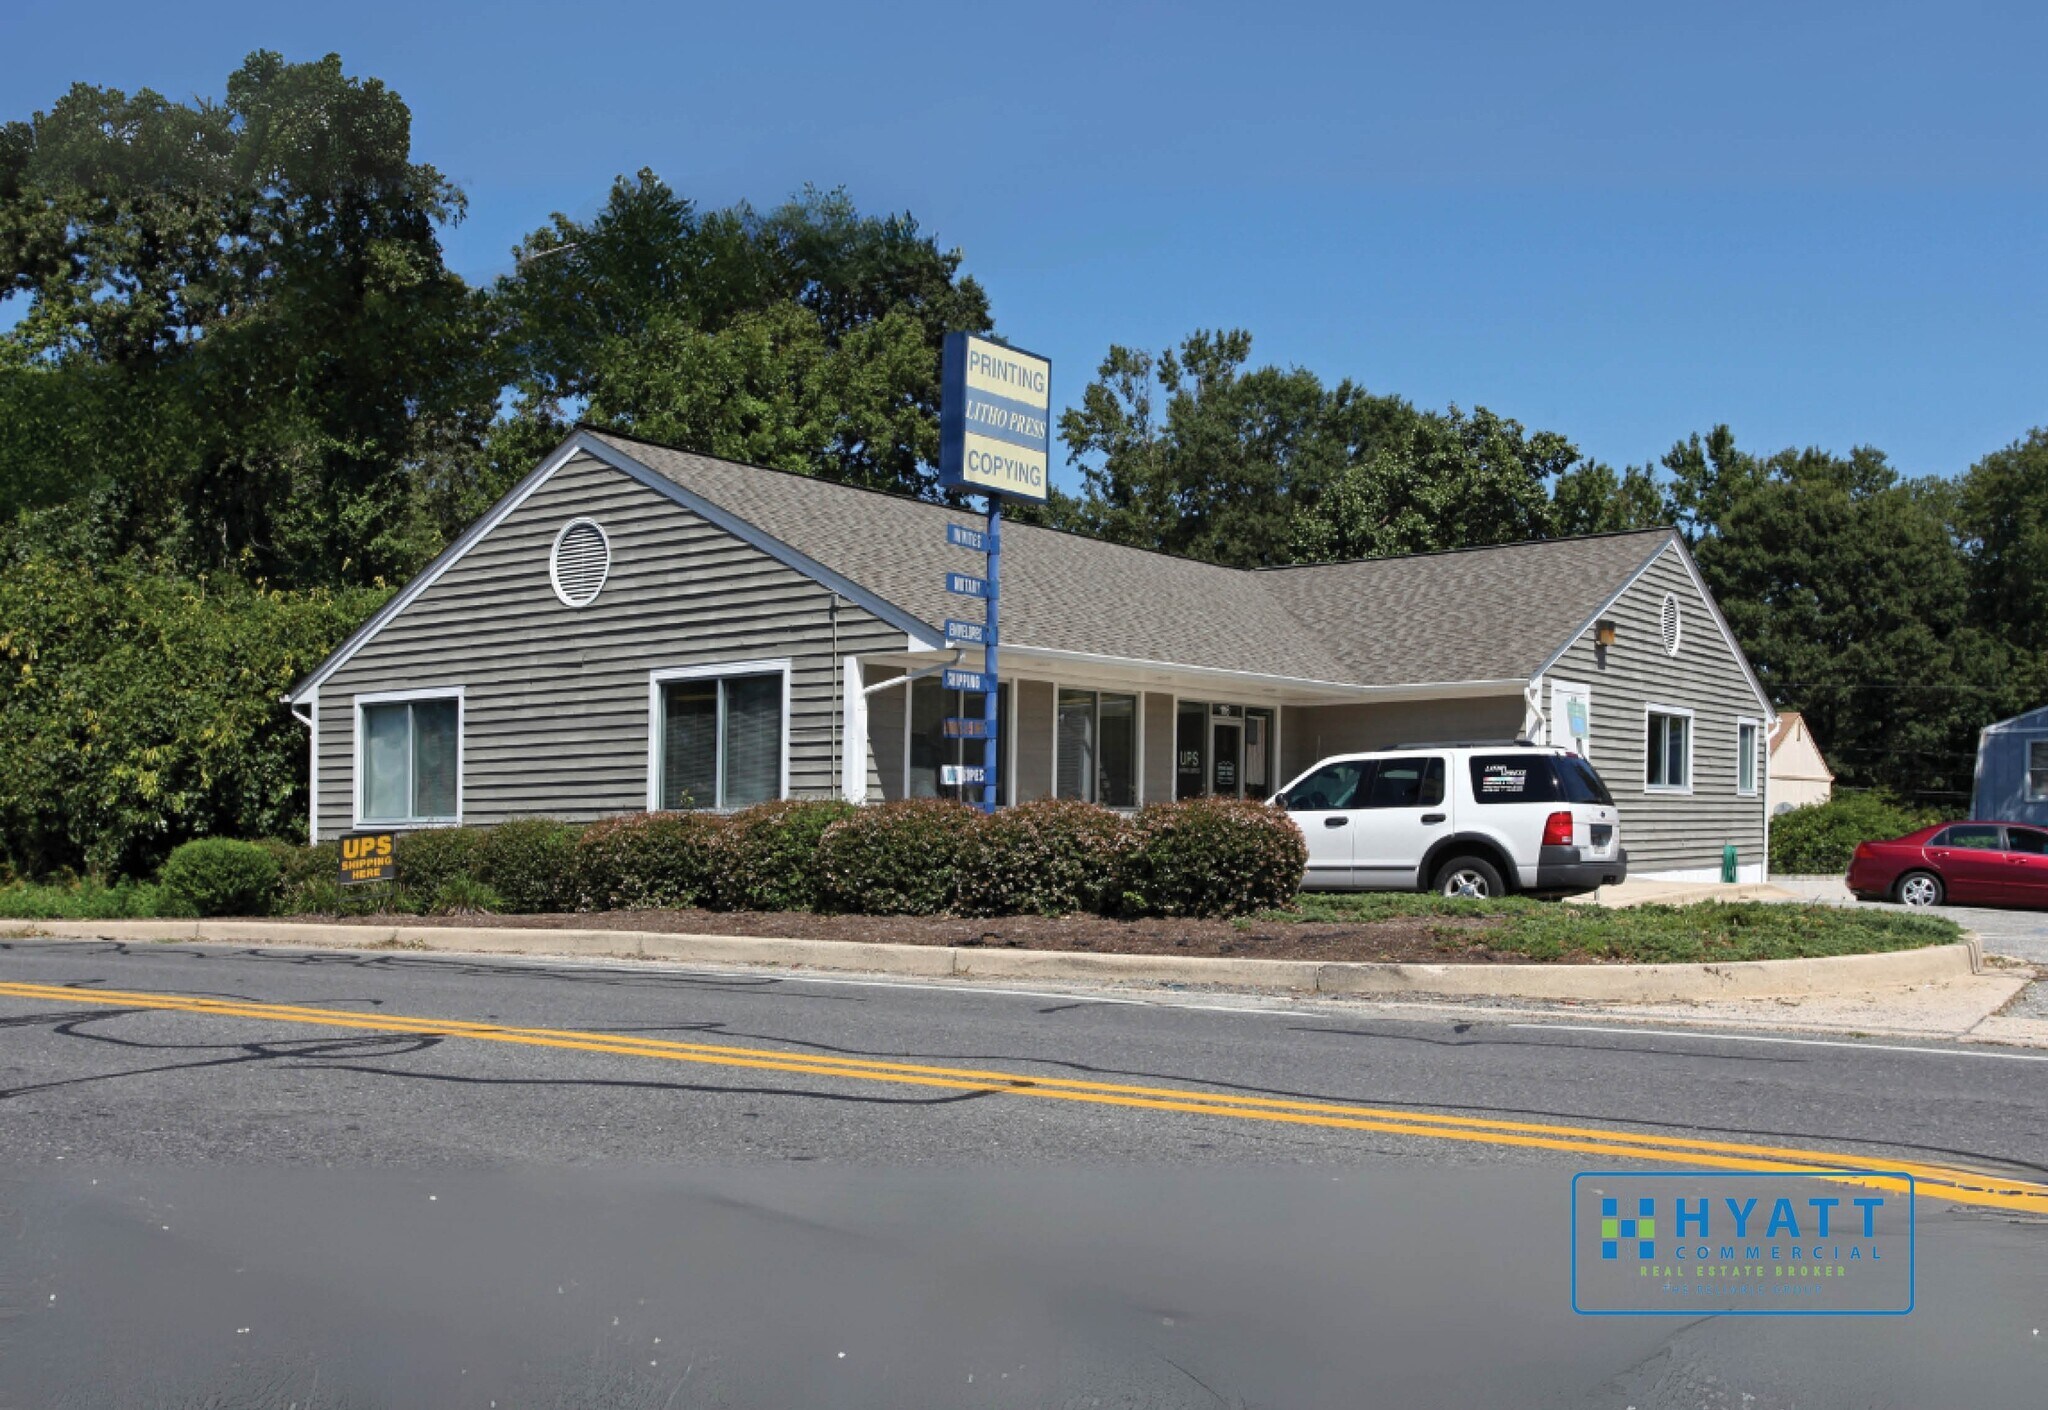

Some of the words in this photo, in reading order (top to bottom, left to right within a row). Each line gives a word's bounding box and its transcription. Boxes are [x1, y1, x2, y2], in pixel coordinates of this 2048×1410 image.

[969, 350, 1045, 393] PRINTING
[965, 400, 1007, 429] LITHO
[1009, 412, 1047, 439] PRESS
[968, 449, 1042, 488] COPYING
[1180, 750, 1199, 767] UPS
[343, 834, 392, 859] UPS
[341, 856, 393, 871] SHIPPING
[352, 867, 381, 880] HERE
